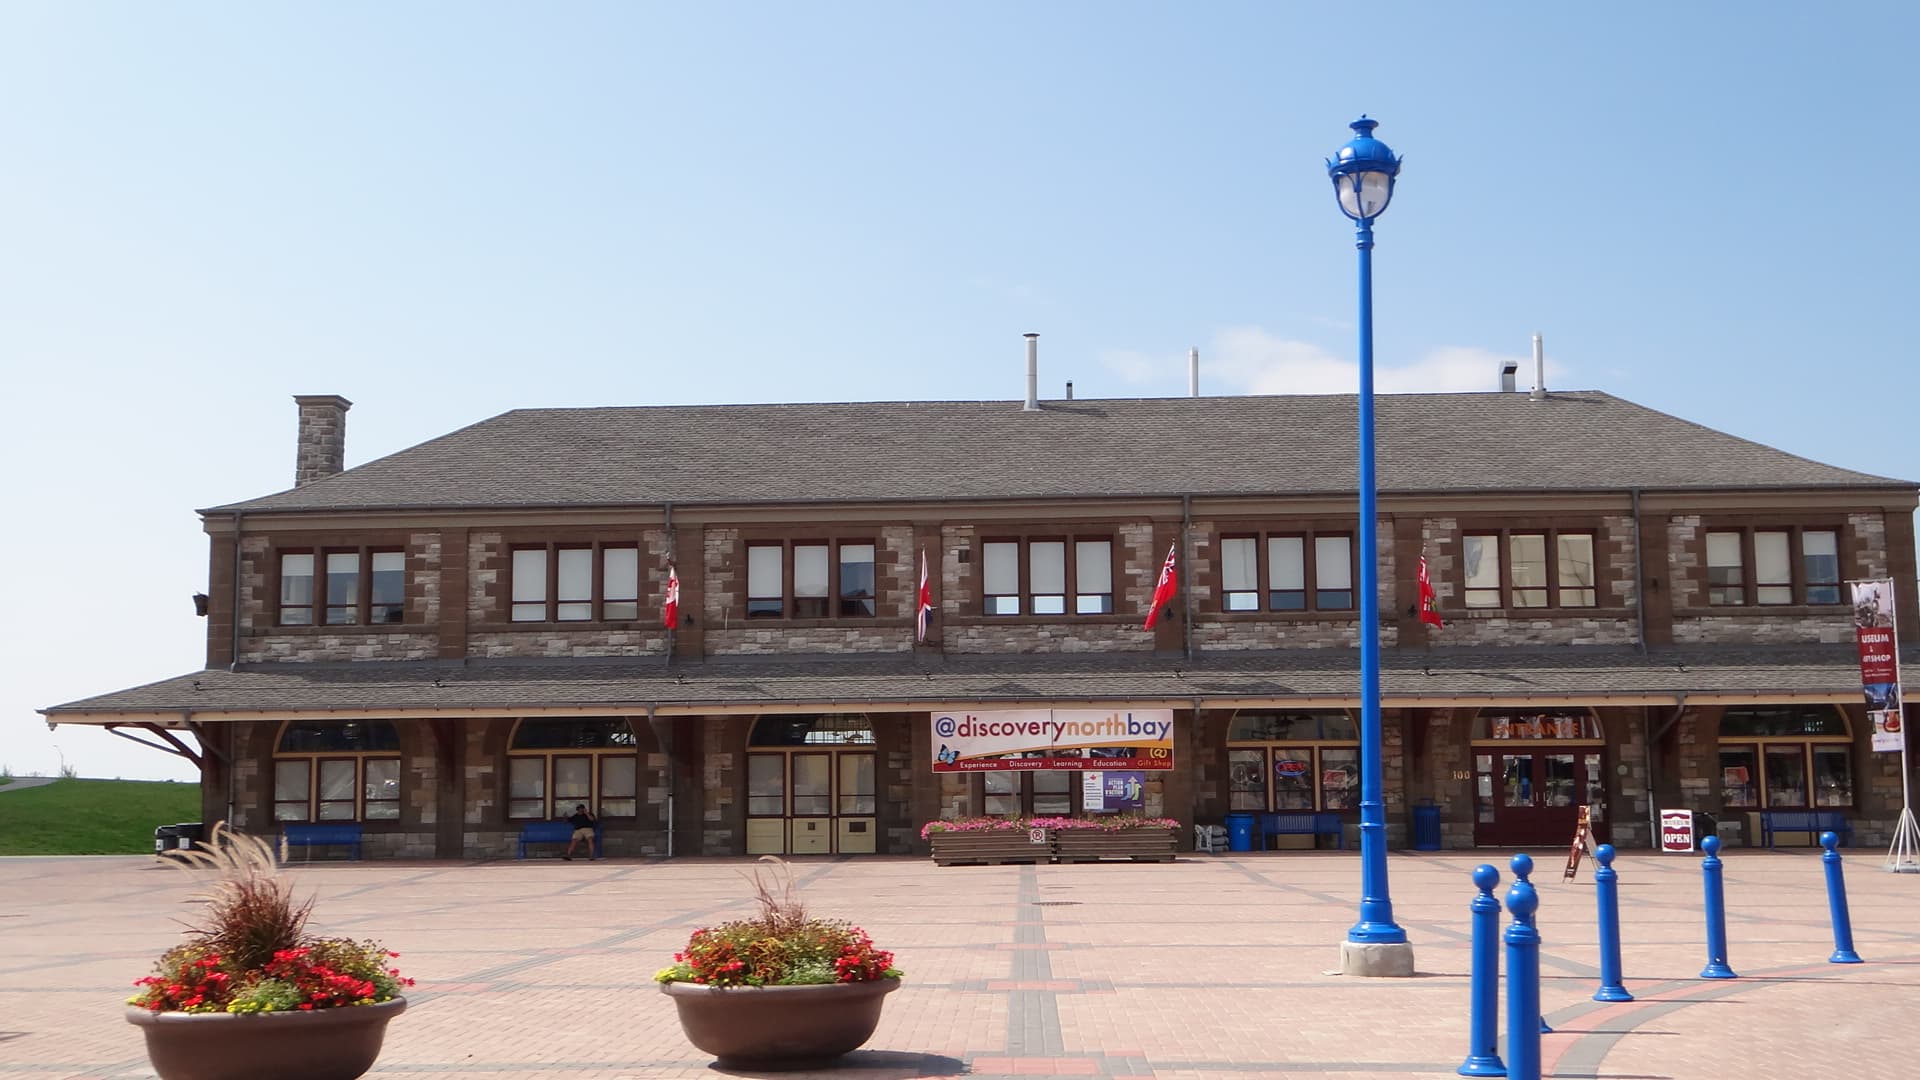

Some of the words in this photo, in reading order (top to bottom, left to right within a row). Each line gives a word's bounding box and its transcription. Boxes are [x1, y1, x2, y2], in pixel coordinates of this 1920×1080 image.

[1861, 634, 1889, 643] USEUM
[935, 713, 1171, 742] @discoverynorthbay
[1493, 721, 1579, 736] ENTRANCE
[1053, 760, 1083, 768] Learning
[1154, 760, 1171, 768] Shop
[1453, 770, 1470, 780] 100
[1664, 833, 1690, 843] OPEN
